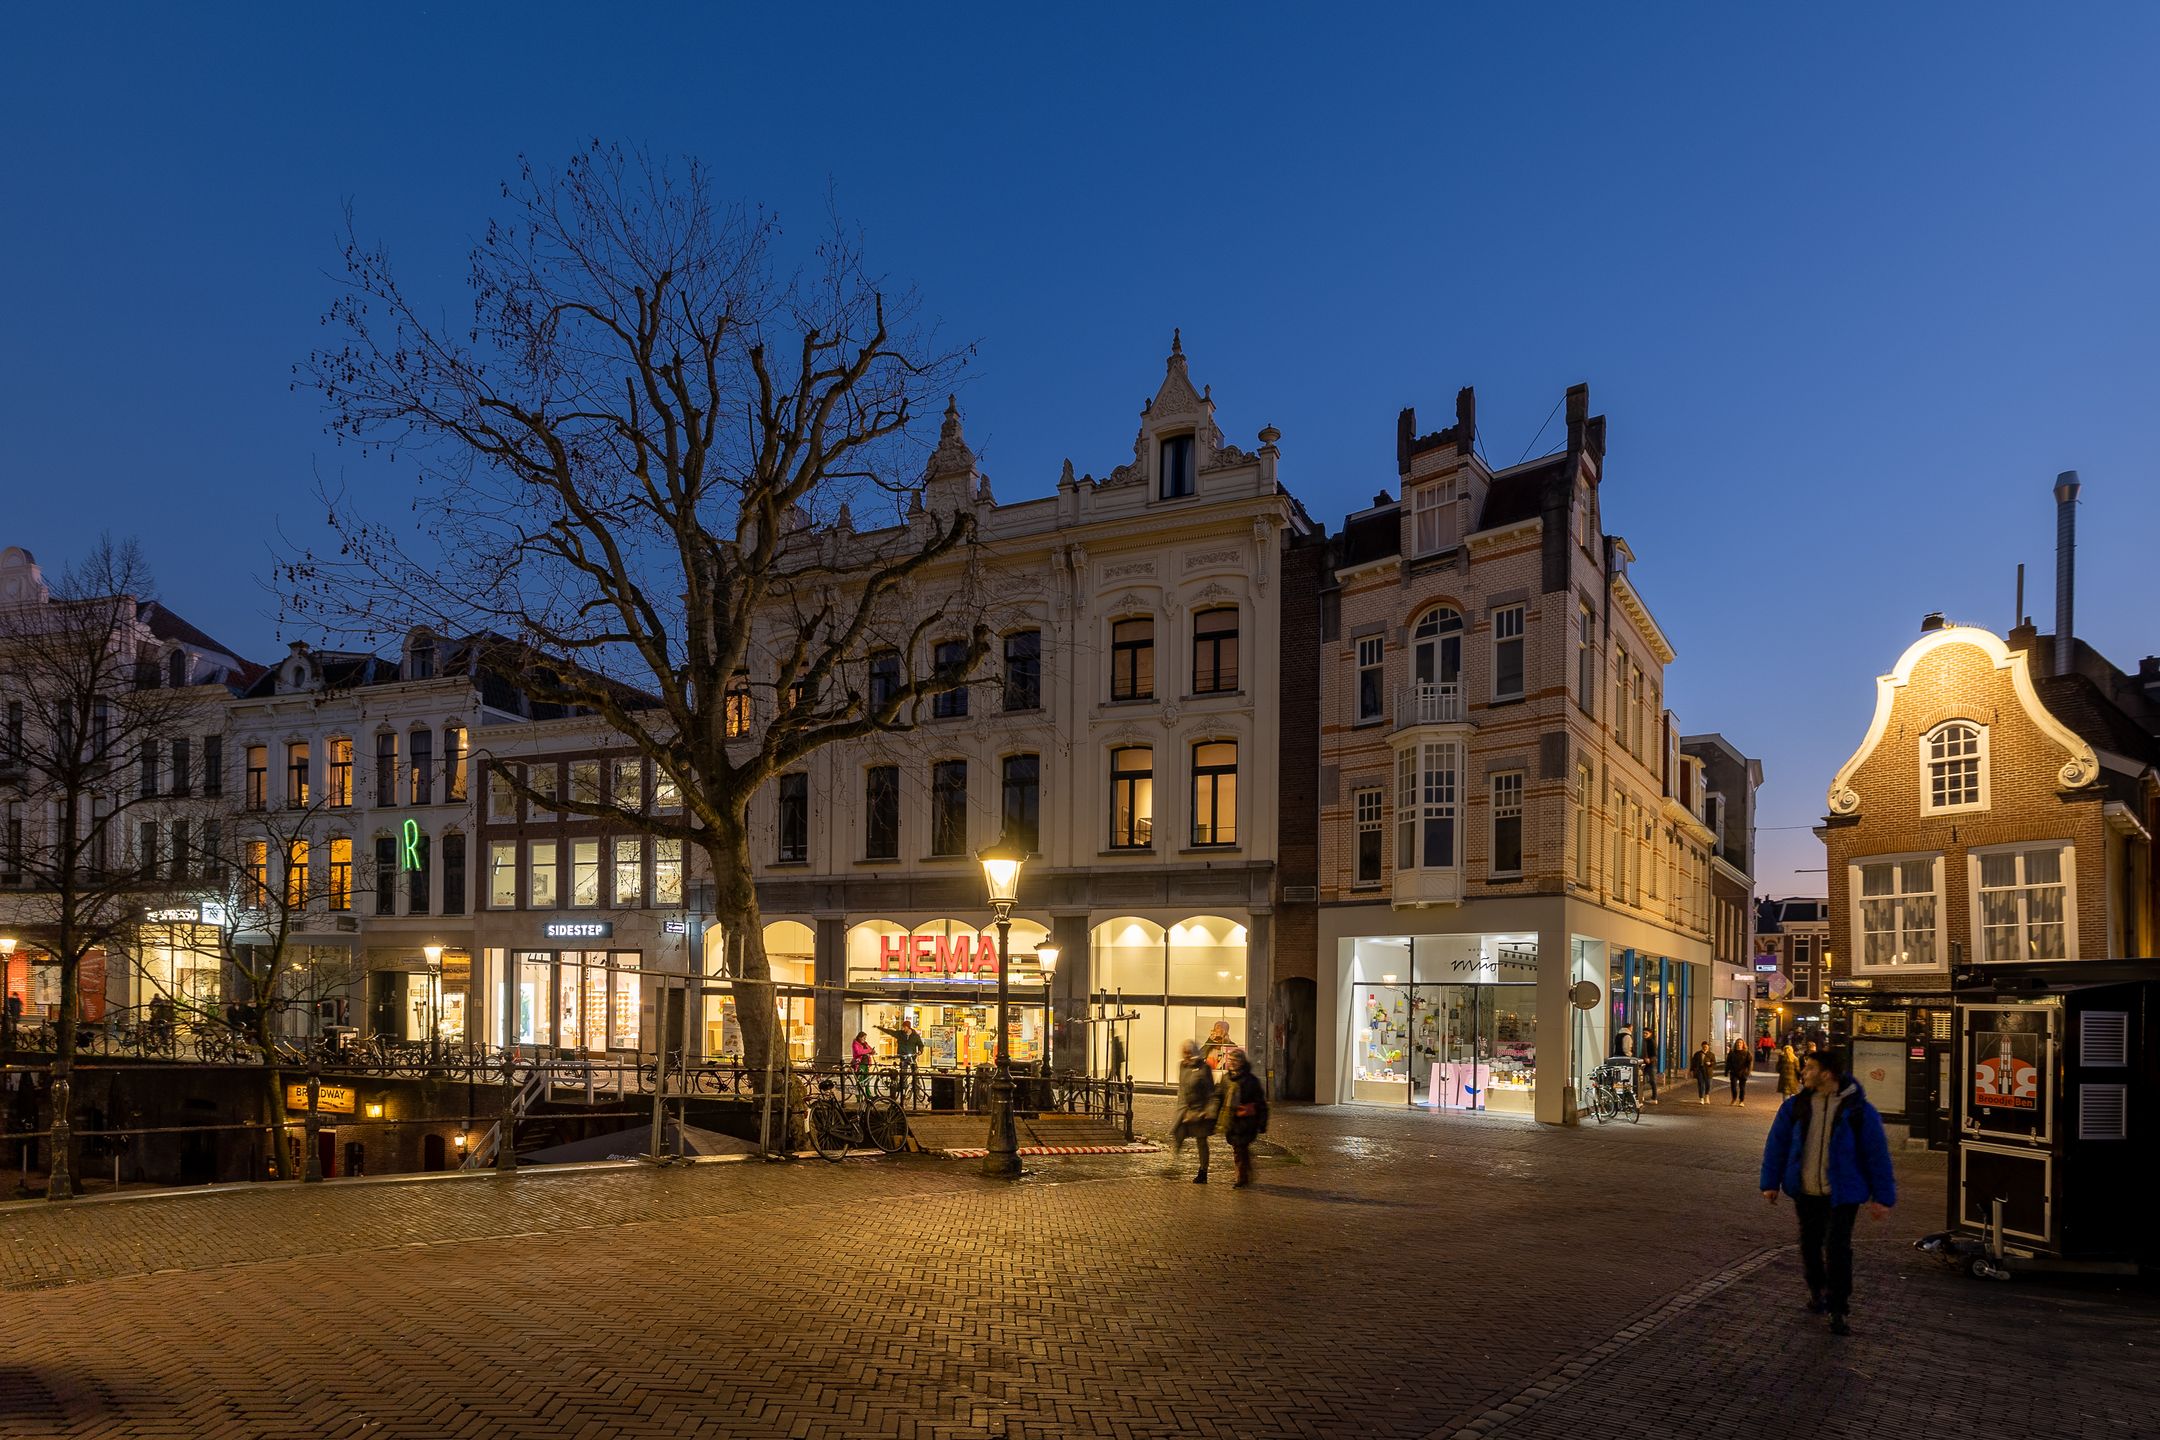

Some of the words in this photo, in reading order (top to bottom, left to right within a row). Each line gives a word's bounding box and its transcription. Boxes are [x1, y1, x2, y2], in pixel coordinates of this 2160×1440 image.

[404, 819, 420, 869] R
[548, 924, 602, 935] SIDESTEP
[880, 935, 999, 973] HEMA
[296, 1087, 345, 1099] BRDWAY
[1978, 1095, 2014, 1106] Broodje
[2015, 1098, 2033, 1107] Ben
